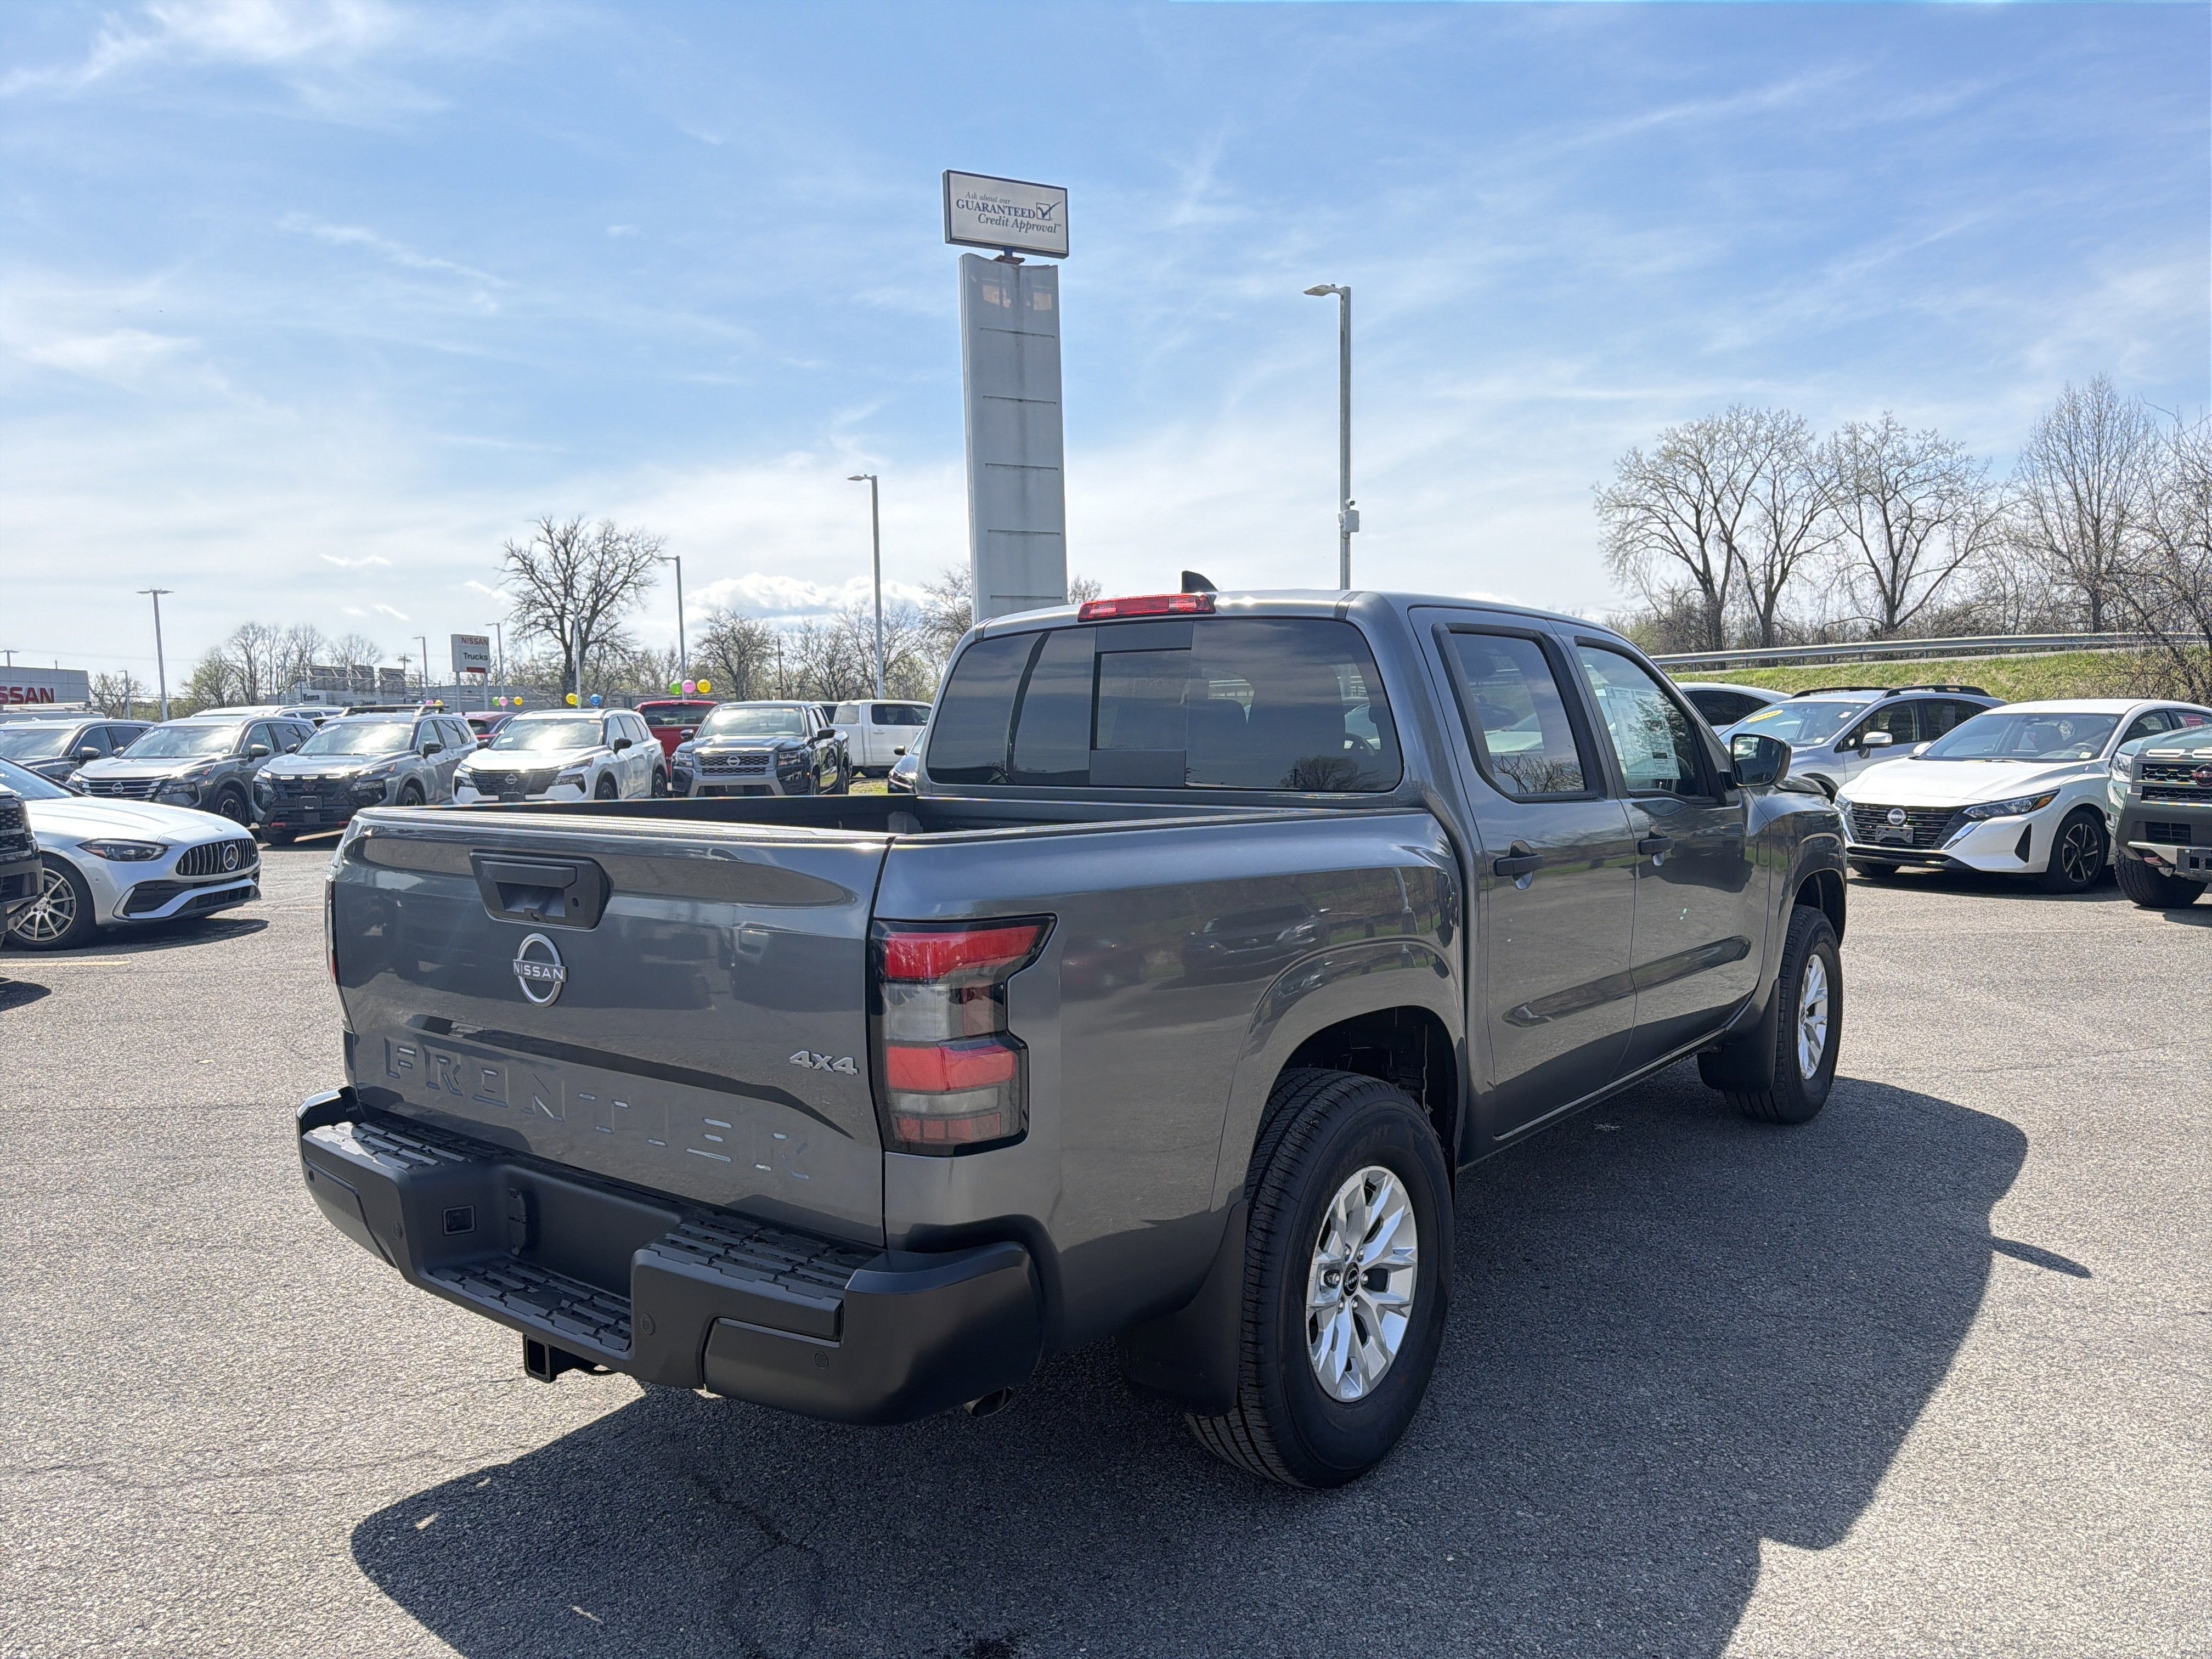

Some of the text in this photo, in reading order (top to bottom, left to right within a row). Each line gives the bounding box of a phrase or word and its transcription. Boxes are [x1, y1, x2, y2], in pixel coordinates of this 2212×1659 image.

[956, 199, 1036, 219] GUARANTEED
[978, 213, 1009, 227] Credit
[461, 637, 488, 645] NISSAN
[463, 652, 488, 661] Trucks
[514, 962, 563, 980] NISSAN
[384, 1036, 811, 1181] FRONTIER
